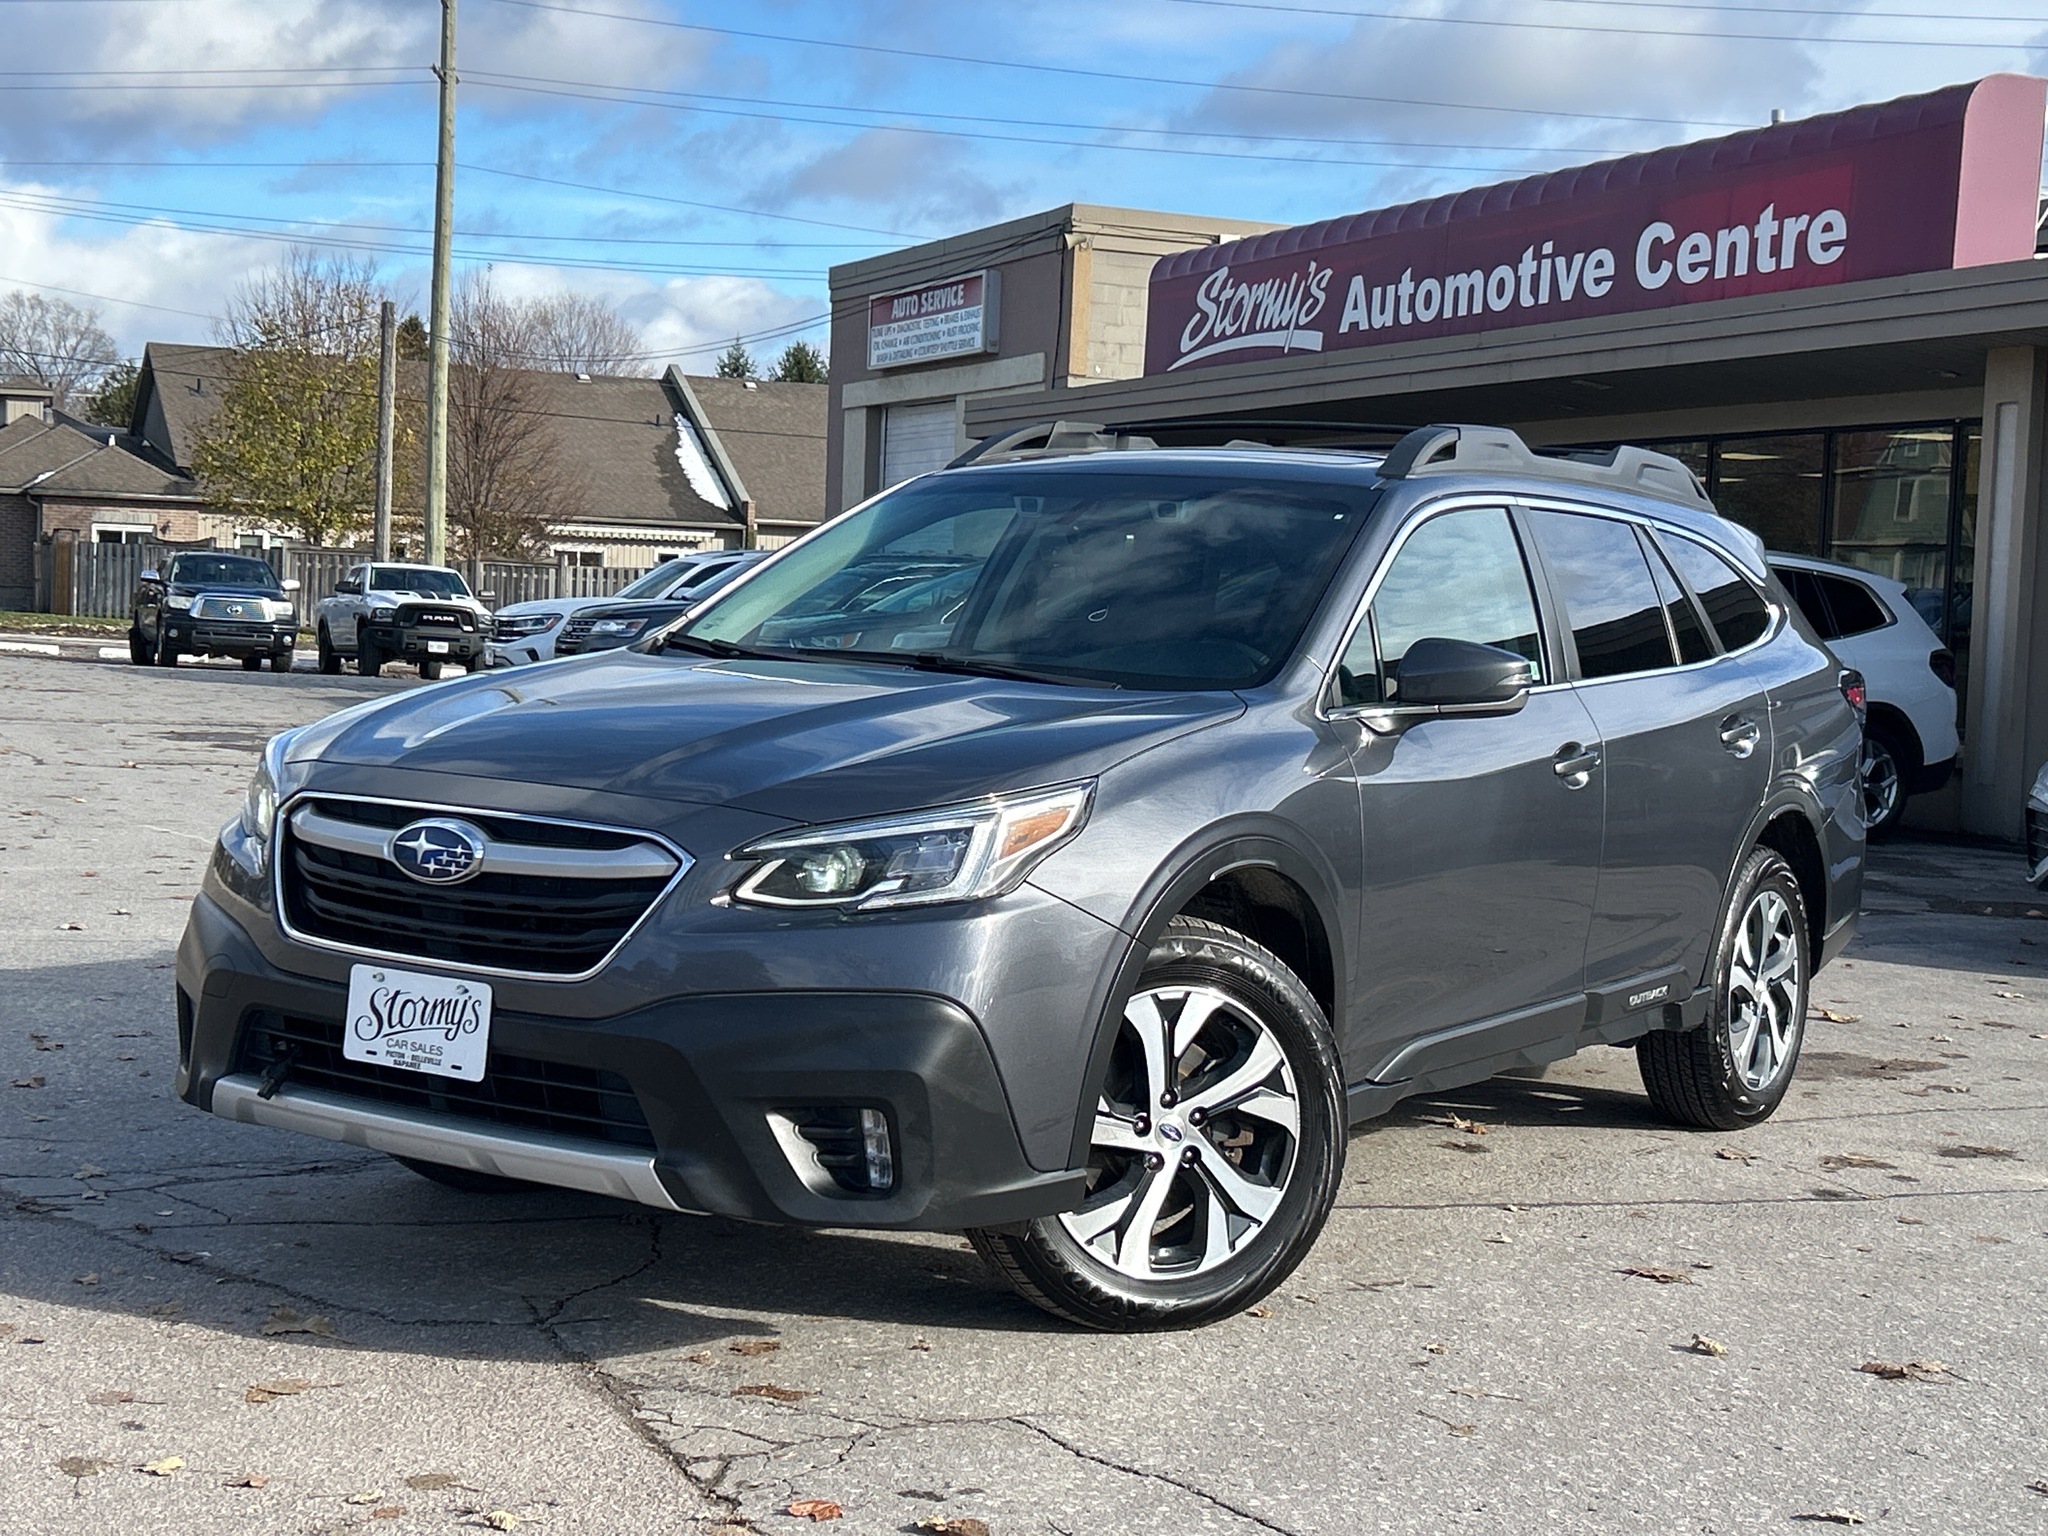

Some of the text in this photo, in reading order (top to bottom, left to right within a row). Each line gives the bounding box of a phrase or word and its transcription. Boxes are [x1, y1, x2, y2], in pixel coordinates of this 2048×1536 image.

[1180, 202, 1848, 354] Stormy's Automotive Centre
[892, 284, 964, 318] AUTO SERVICE
[1629, 985, 1668, 1006] OUTBACK
[355, 987, 481, 1040] Stormy's
[386, 1038, 443, 1056] CAR SALES
